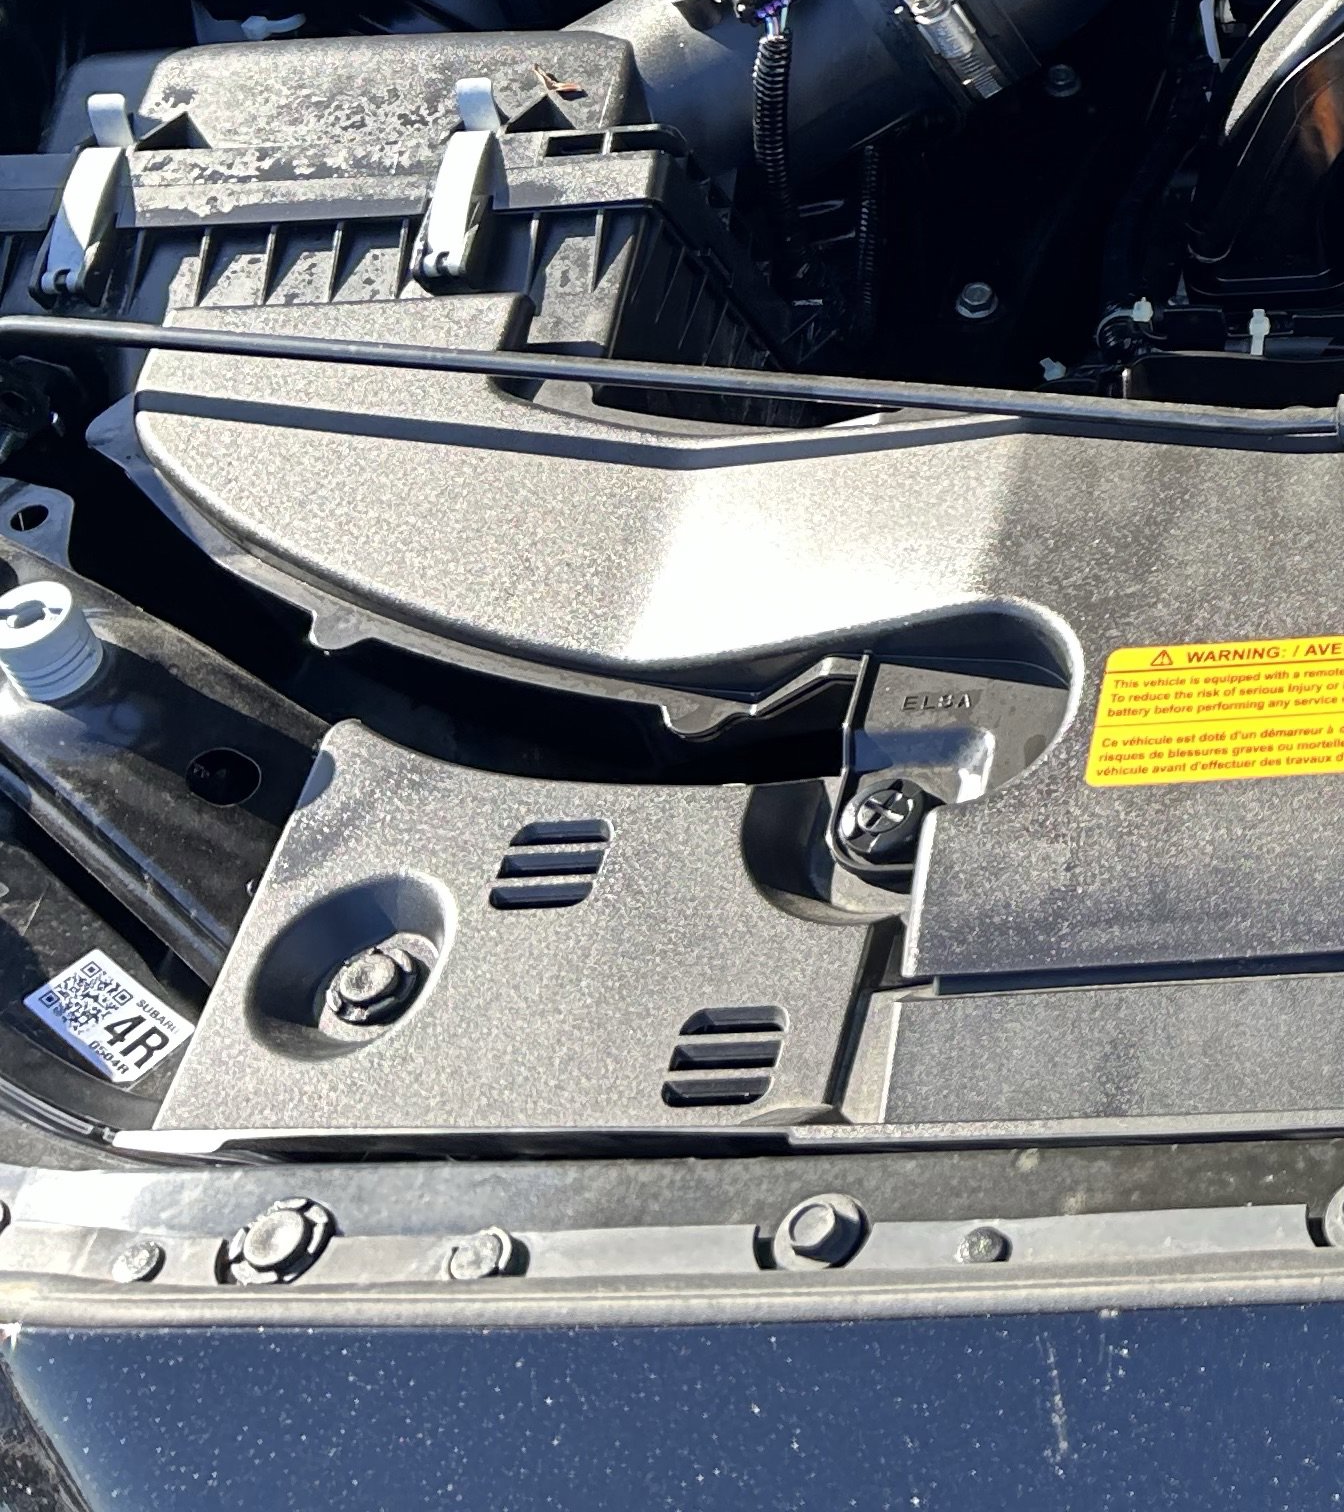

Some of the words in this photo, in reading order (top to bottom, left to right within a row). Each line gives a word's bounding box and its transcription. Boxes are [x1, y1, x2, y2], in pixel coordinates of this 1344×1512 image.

[1113, 678, 1139, 689] This
[1142, 676, 1187, 689] vehicle
[1190, 675, 1201, 686] is
[1203, 671, 1261, 687] equipped
[1264, 669, 1291, 681] with
[1293, 671, 1300, 680] a
[1110, 693, 1126, 704] To
[1128, 690, 1172, 703] reduce
[1174, 689, 1194, 700] the
[1197, 688, 1221, 699] risk
[1223, 686, 1237, 697] of
[1239, 684, 1285, 696] serious
[1287, 680, 1323, 694] Injury
[1326, 681, 1340, 691] or
[1107, 706, 1151, 719] battery
[1153, 702, 1194, 715] before
[1196, 698, 1265, 714] performing
[1267, 696, 1291, 709] any
[1294, 694, 1338, 707] service
[1101, 737, 1119, 749] Ce
[1122, 733, 1173, 747] véhicule
[1176, 732, 1196, 744] est
[1199, 730, 1227, 742] doté
[1230, 728, 1257, 741] d'un
[1259, 724, 1324, 739] démarreur
[1098, 750, 1145, 763] risques
[1149, 748, 1165, 759] de
[1167, 745, 1229, 759] blessures
[1231, 743, 1274, 757] graves
[1277, 742, 1294, 752] ou
[1096, 763, 1149, 777] véhicule
[1151, 762, 1187, 774] avant
[1190, 758, 1257, 772] d'effectuer
[1259, 756, 1282, 768] des
[1285, 753, 1332, 766] travaux
[104, 1014, 170, 1070] 4R
[87, 1039, 130, 1075] 0504R
